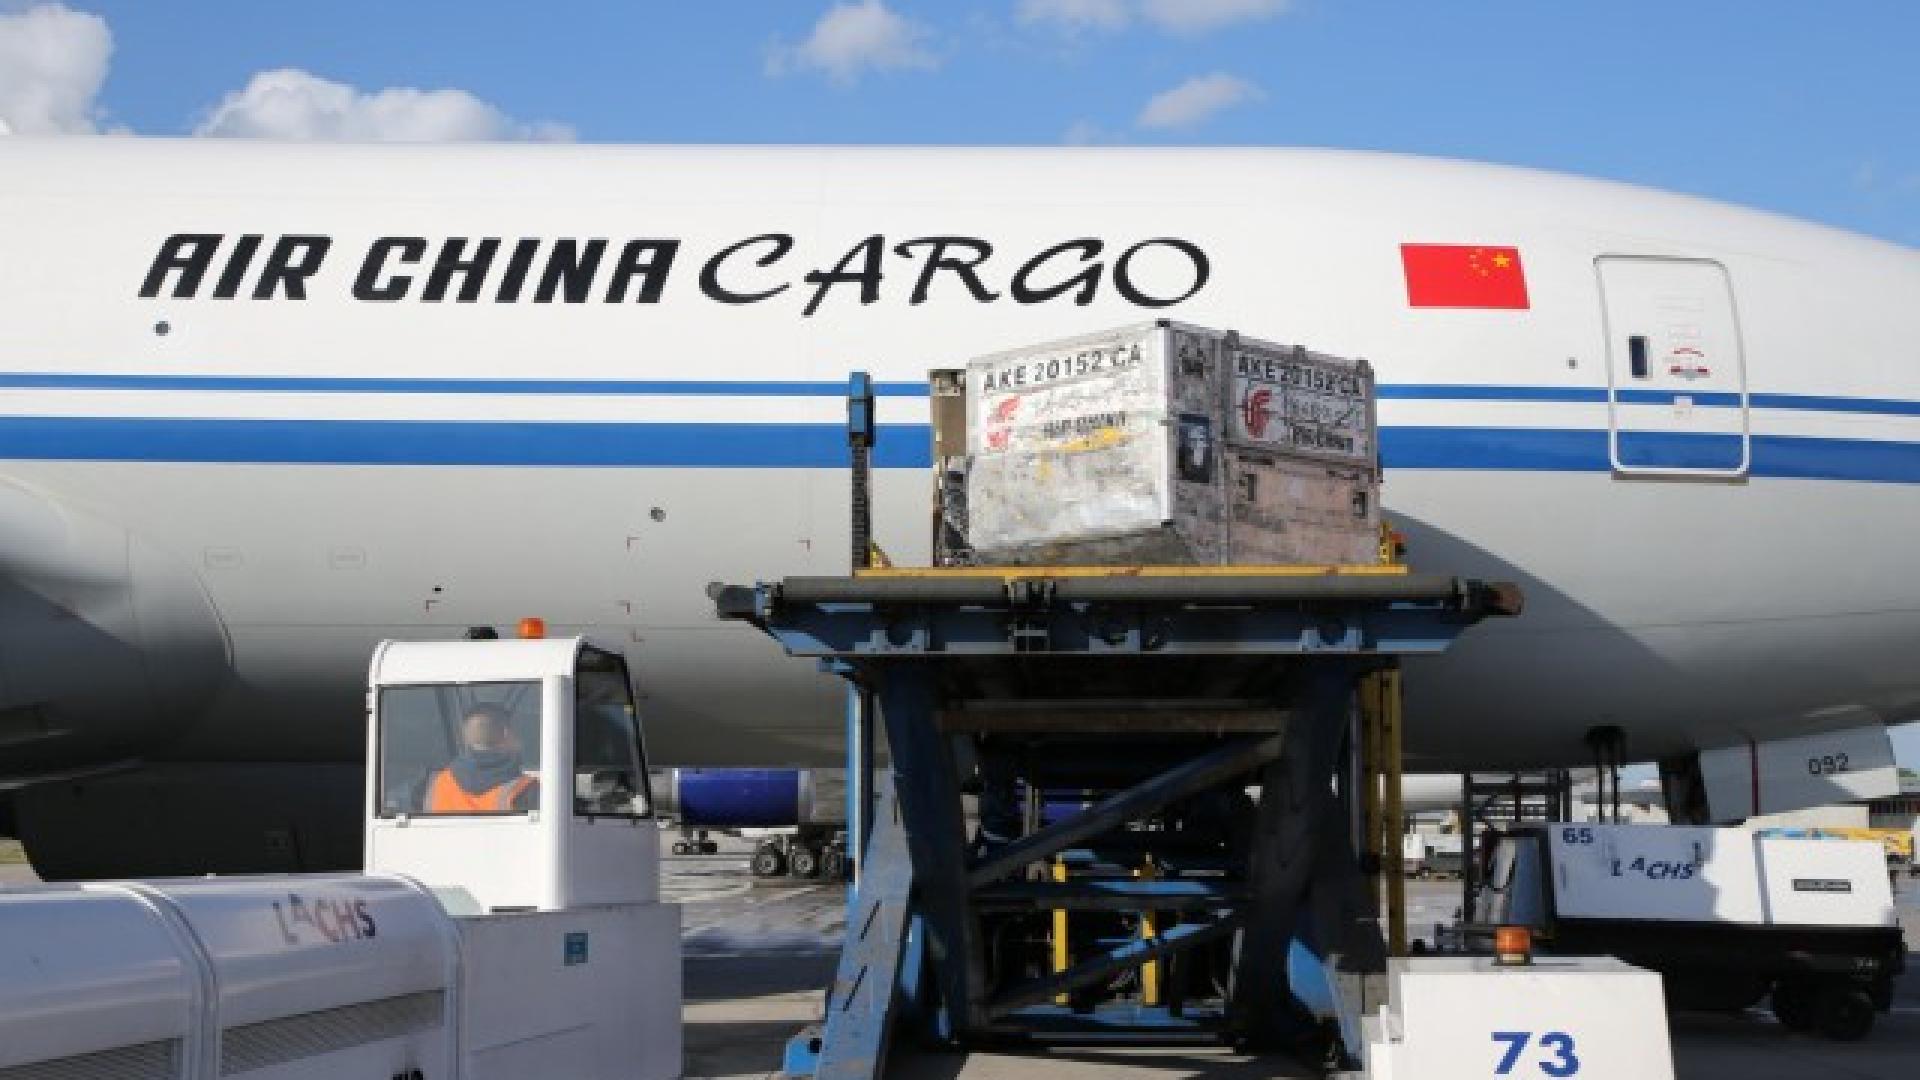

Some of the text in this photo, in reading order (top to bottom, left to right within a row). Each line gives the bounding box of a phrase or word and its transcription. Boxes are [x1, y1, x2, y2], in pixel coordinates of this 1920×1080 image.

[138, 233, 1211, 317] AIR CHINA CARGO
[984, 343, 1141, 391] AKE 20152 CA
[1238, 355, 1275, 380] AKE
[1808, 752, 1849, 775] 092
[1562, 827, 1593, 844] 65
[1491, 1031, 1580, 1078] 73
